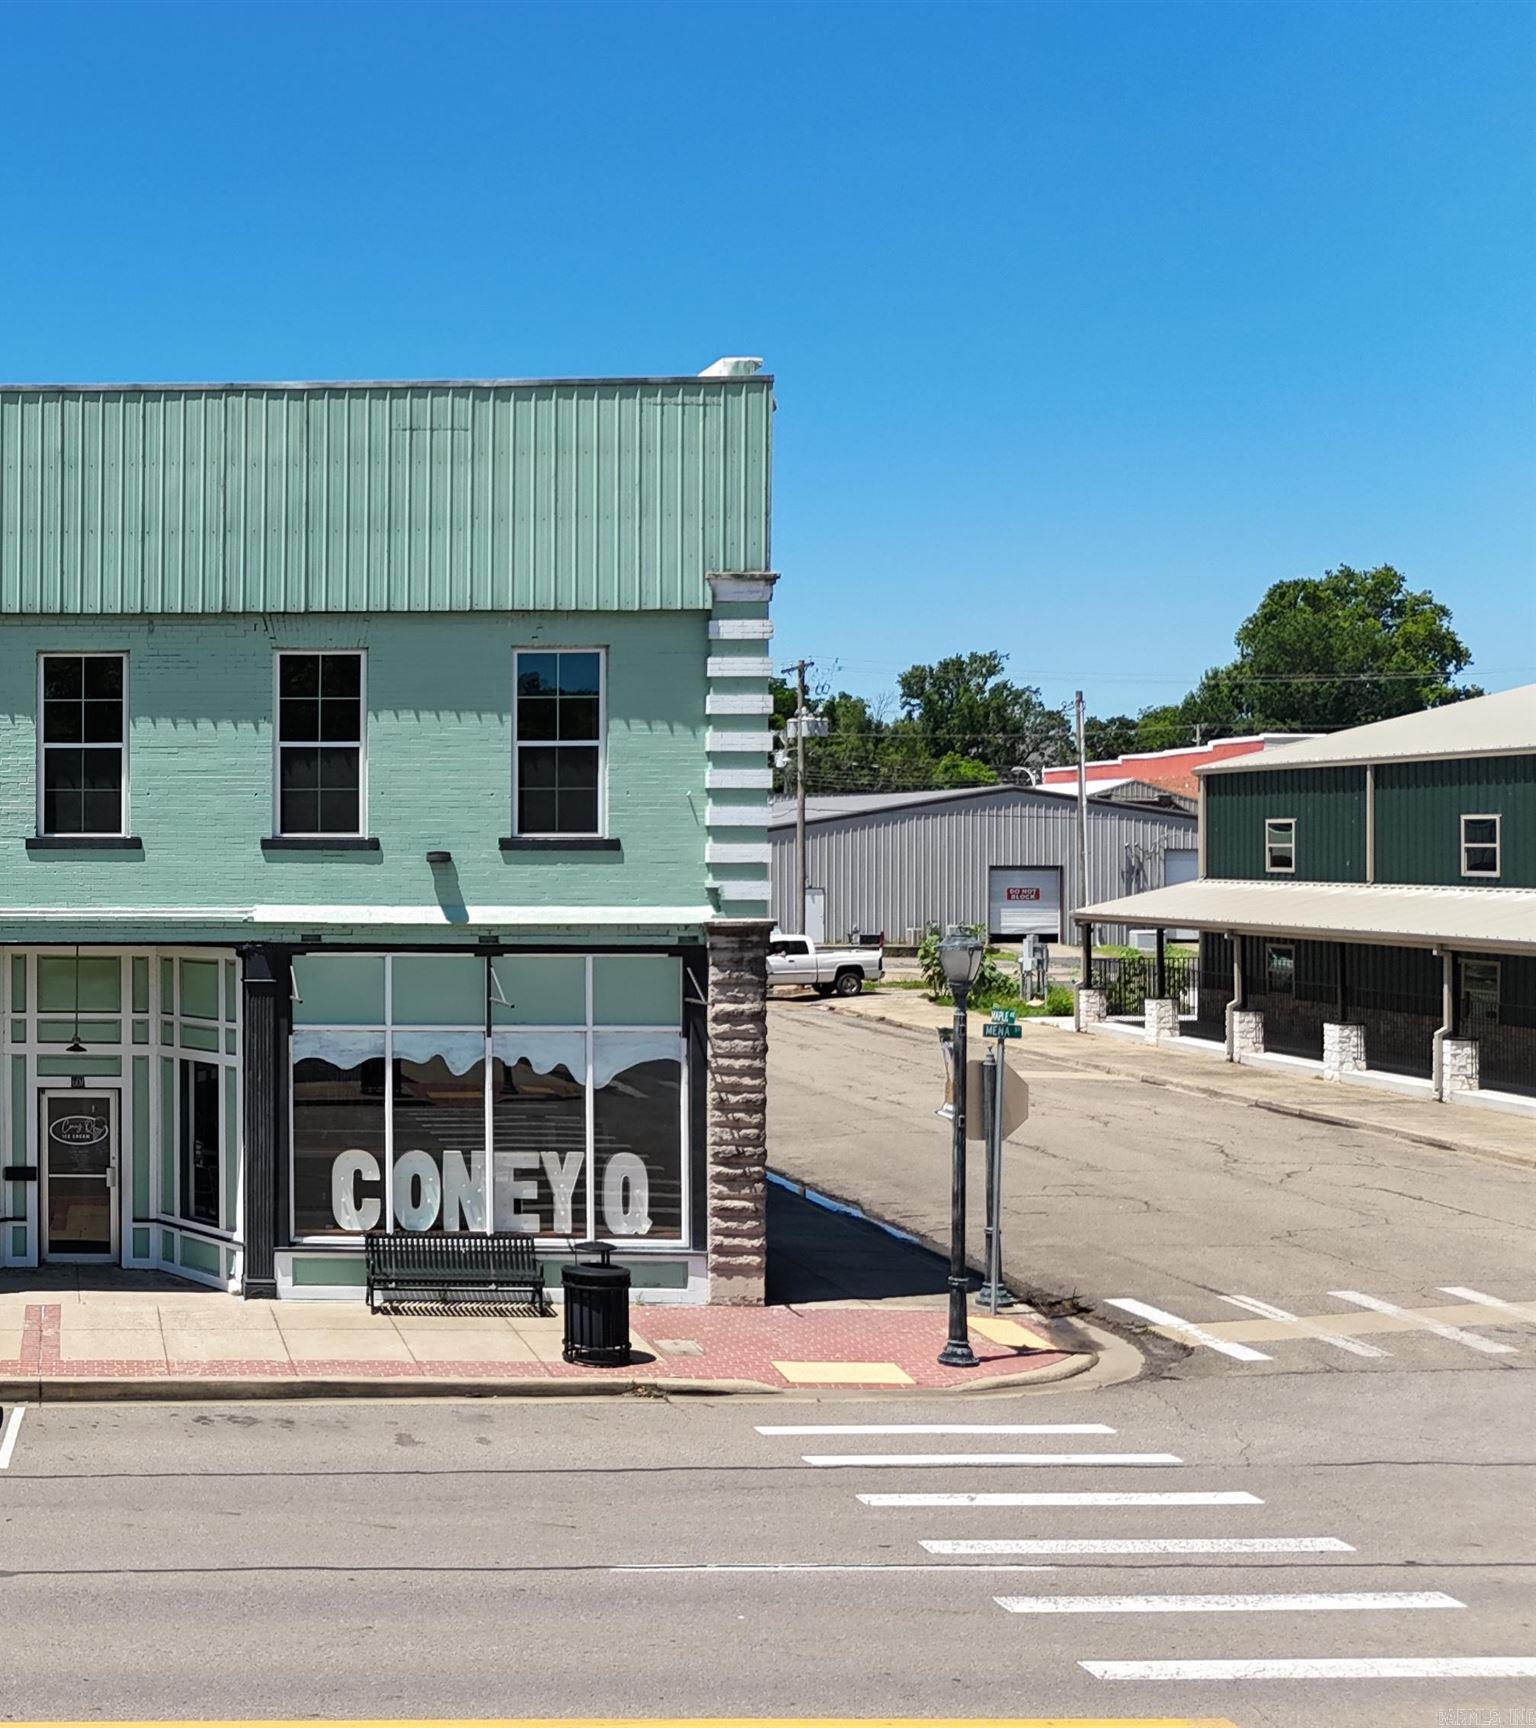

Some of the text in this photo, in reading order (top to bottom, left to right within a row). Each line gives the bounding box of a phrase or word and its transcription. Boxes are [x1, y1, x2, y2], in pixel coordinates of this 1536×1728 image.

[985, 1025, 1010, 1037] MENA
[331, 1149, 654, 1235] CONEY Q
